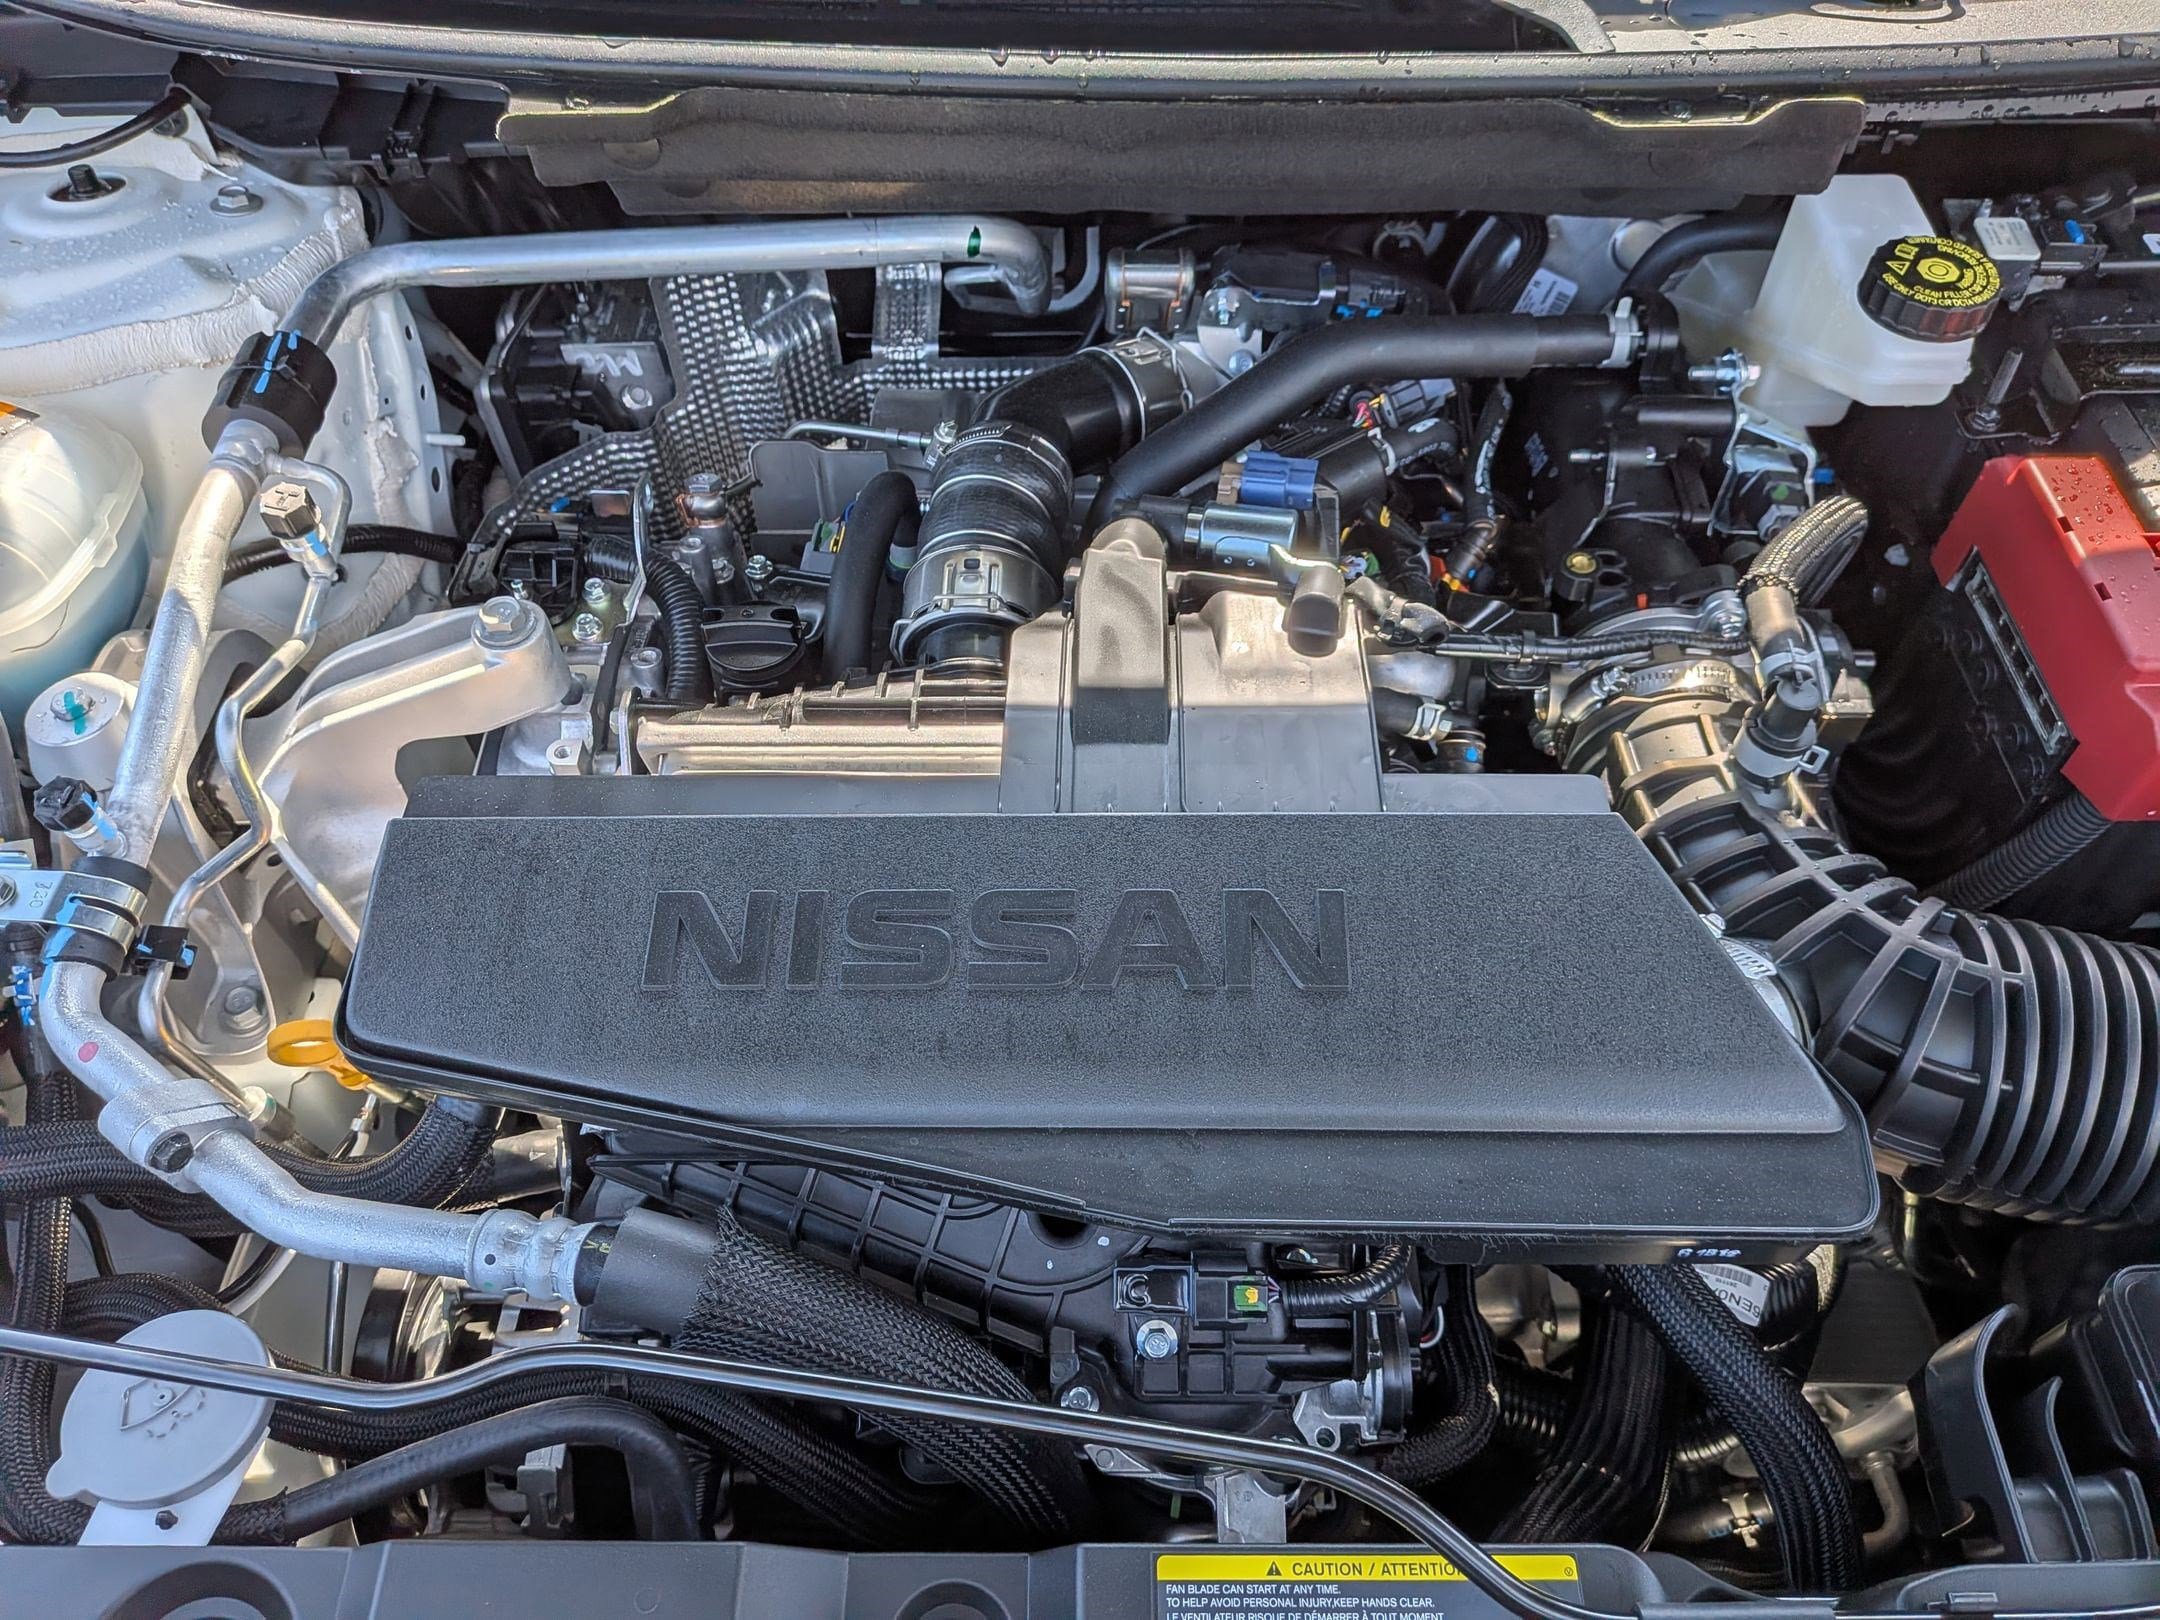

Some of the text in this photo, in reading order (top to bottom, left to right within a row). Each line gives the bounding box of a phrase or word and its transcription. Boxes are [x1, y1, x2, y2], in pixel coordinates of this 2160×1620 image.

[1913, 285, 1942, 298] CLEAN
[641, 889, 1350, 991] NISSAN
[1292, 1563, 1363, 1576] CAUTION
[1381, 1563, 1461, 1576] ATTENTIO
[1166, 1584, 1341, 1595] FAN BLADE CAN START AT ANY TIME.
[1166, 1597, 1180, 1608] TO
[1182, 1597, 1208, 1608] HELP
[1210, 1597, 1241, 1608] AVOID
[1243, 1597, 1297, 1608] PERSONAL
[1361, 1597, 1397, 1608] HANDS
[1399, 1597, 1435, 1608] CLEAR.
[1304, 1610, 1360, 1620] DÉMARRER
